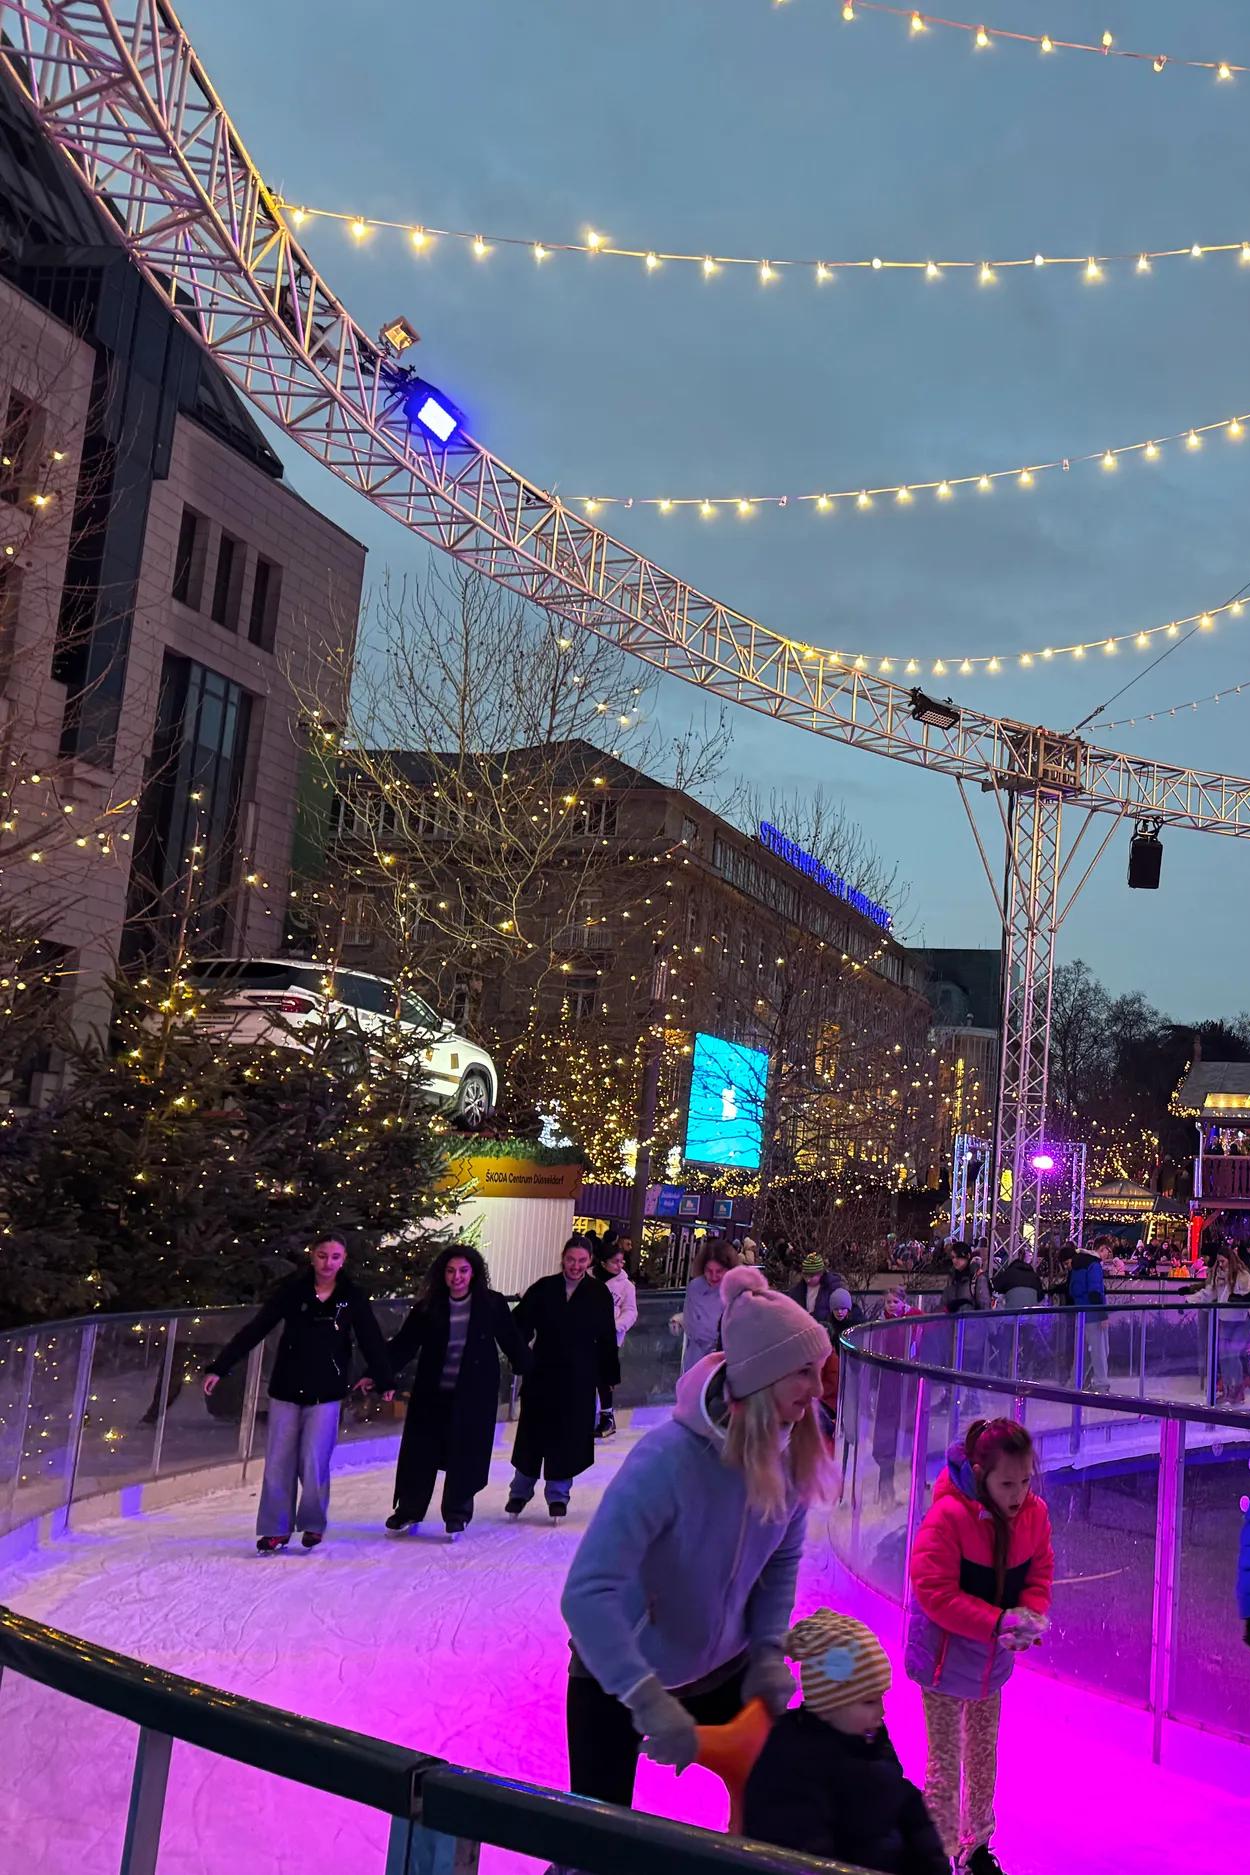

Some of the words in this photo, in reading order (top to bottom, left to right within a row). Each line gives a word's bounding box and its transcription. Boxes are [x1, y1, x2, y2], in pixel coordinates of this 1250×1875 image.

[485, 1168, 507, 1183] ŠKODA
[508, 1172, 533, 1184] Centrum
[533, 1173, 563, 1185] Düsseldorf
